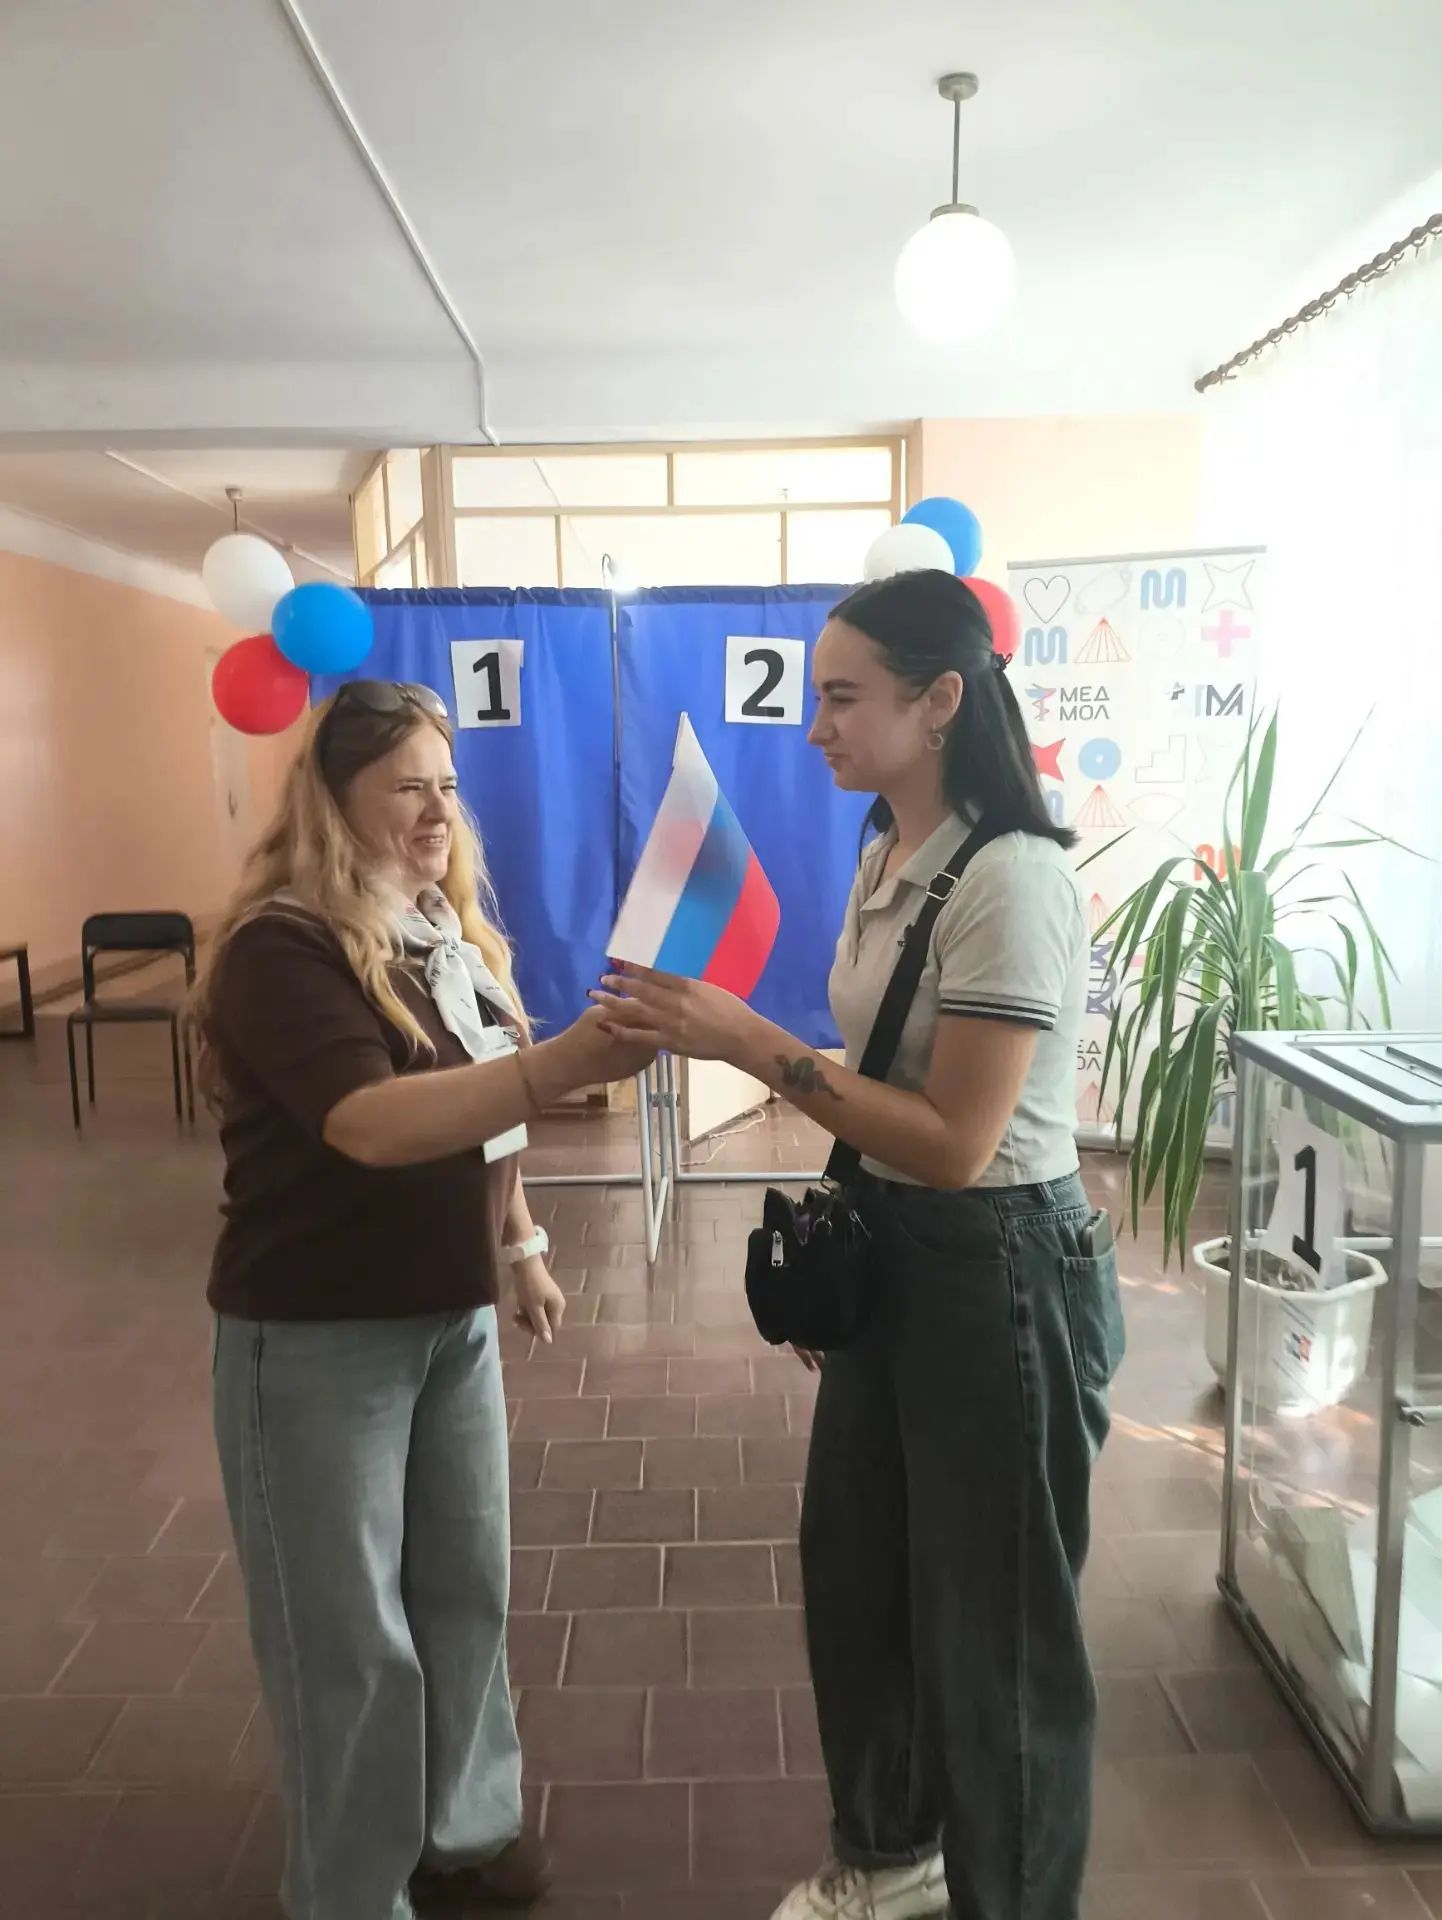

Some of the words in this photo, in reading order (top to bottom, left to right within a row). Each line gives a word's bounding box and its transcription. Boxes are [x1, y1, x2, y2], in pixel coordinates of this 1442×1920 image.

[472, 652, 511, 721] 1
[741, 648, 786, 718] 2
[1060, 686, 1110, 703] МЕД
[1060, 704, 1110, 721] МОЛ
[1292, 1144, 1321, 1274] 1
